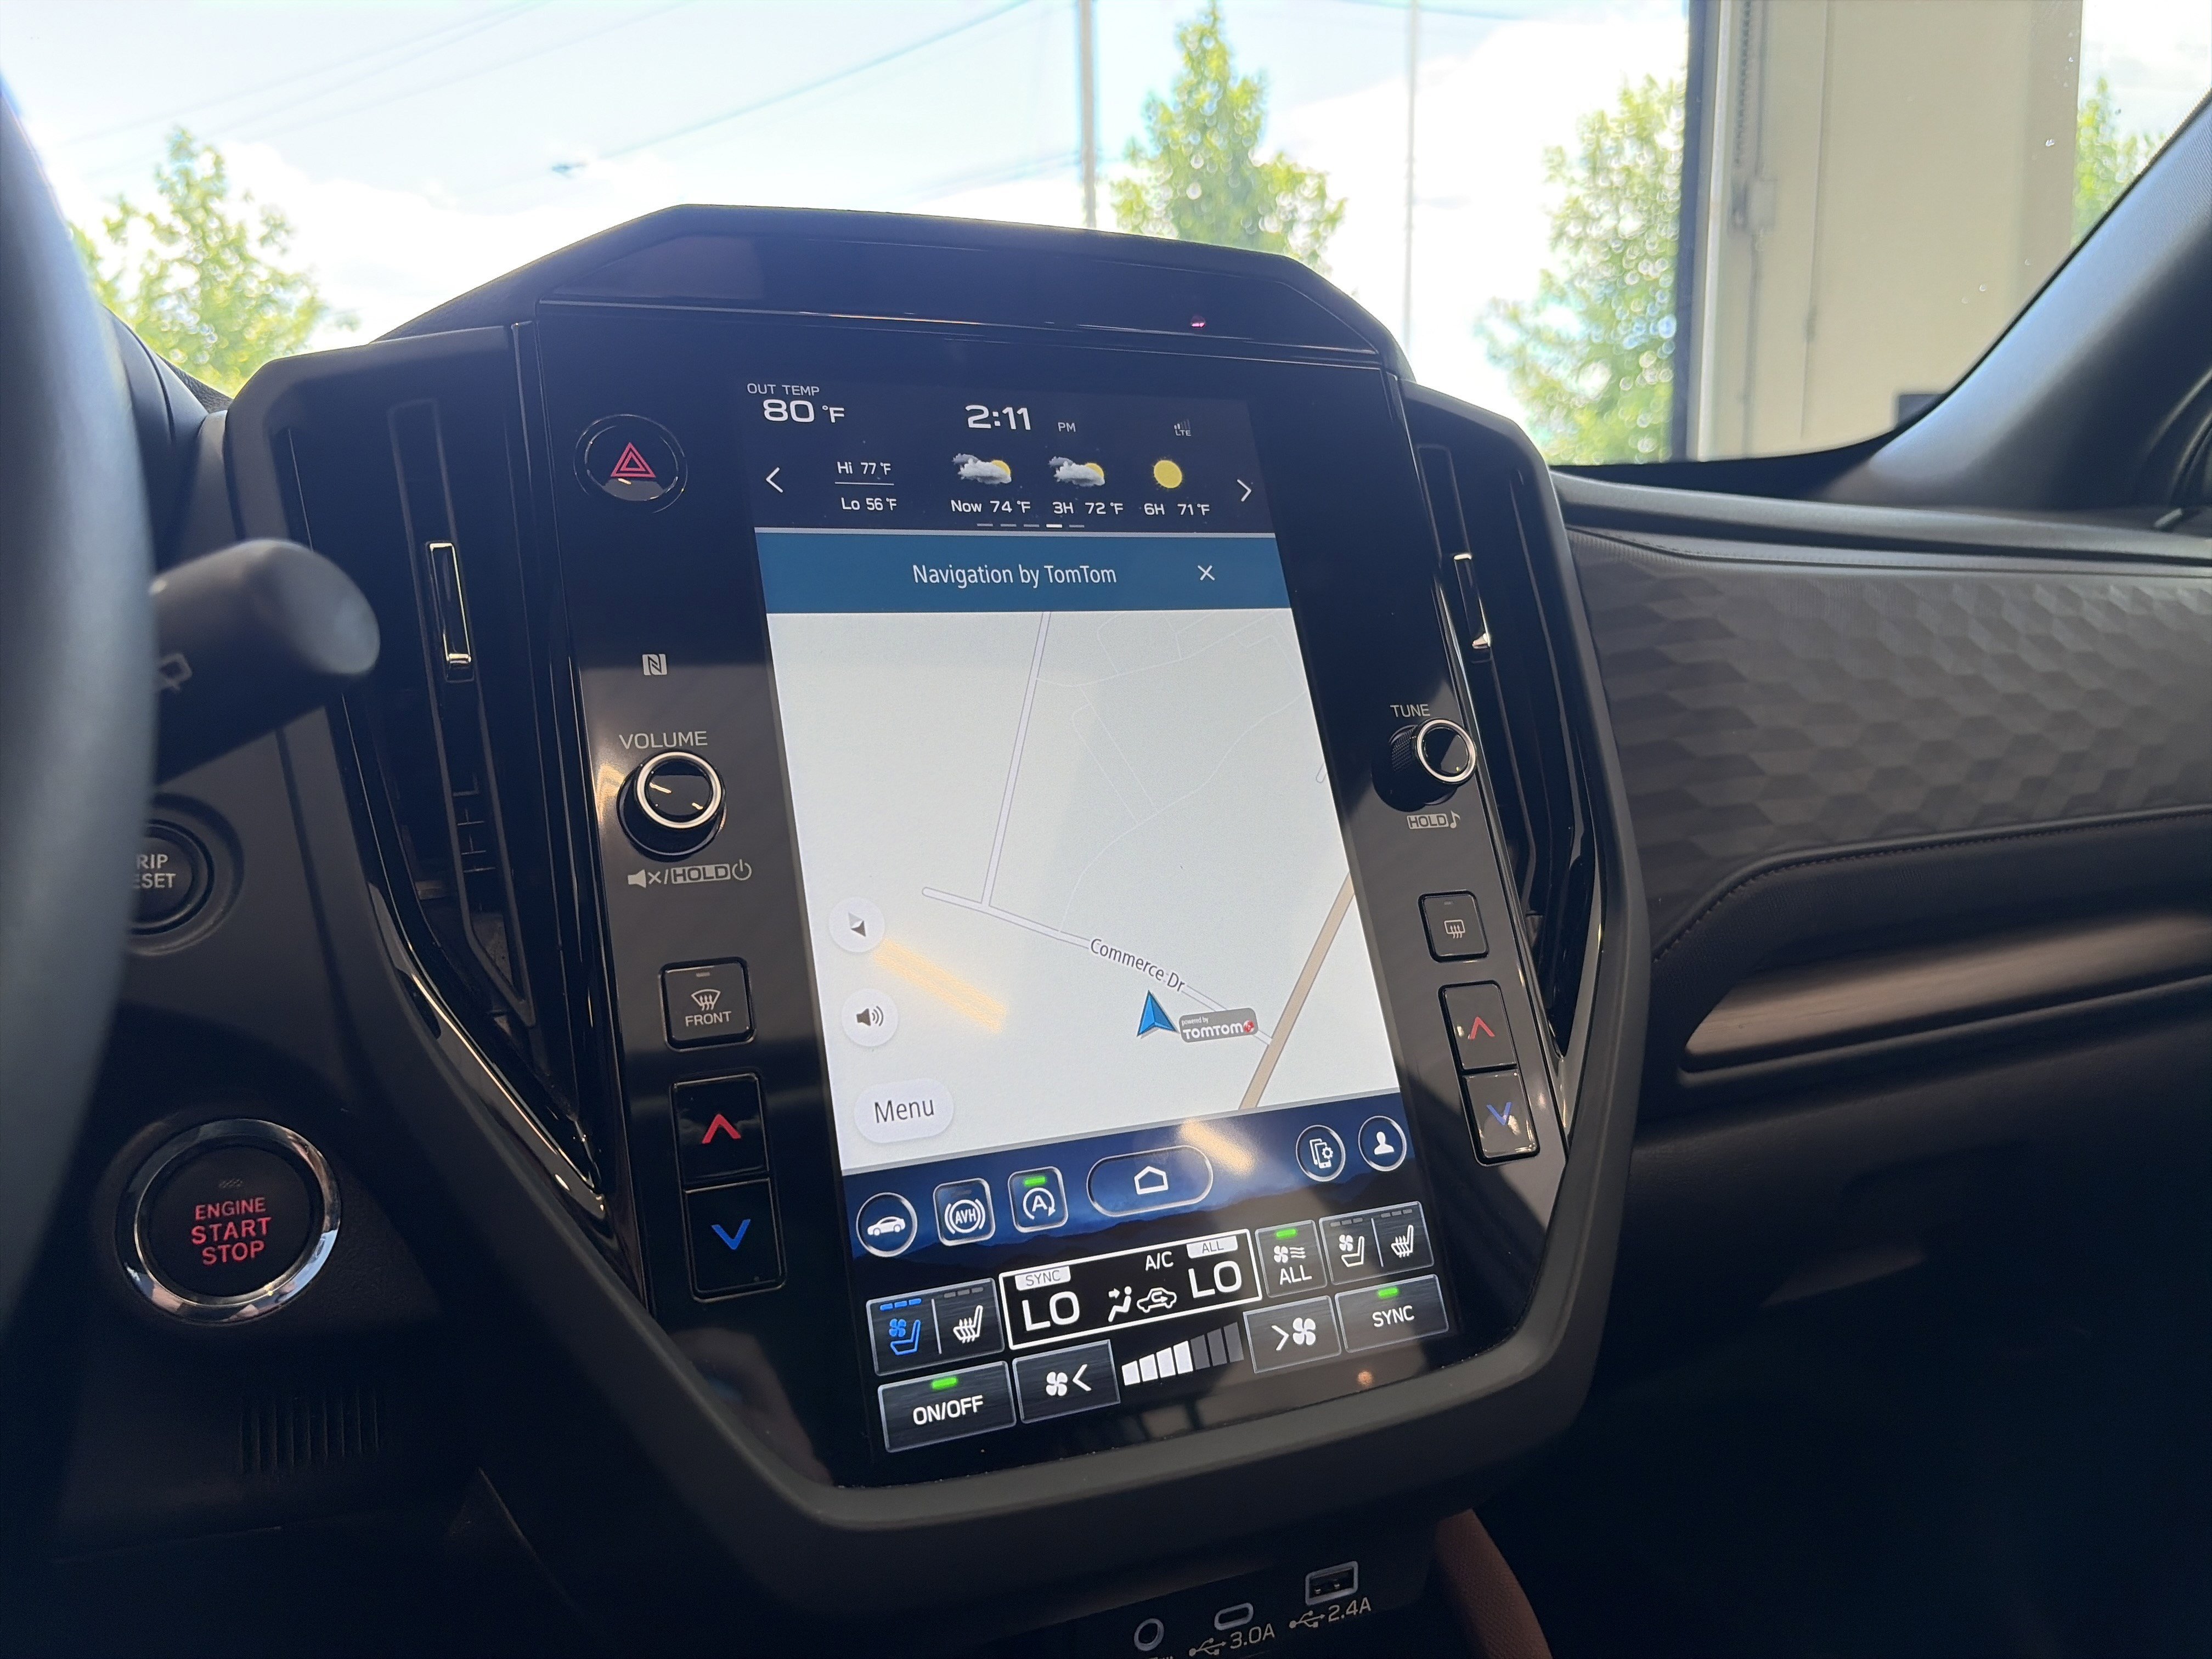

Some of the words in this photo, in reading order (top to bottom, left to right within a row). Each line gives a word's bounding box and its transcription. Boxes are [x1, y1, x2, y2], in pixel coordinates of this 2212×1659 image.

[747, 383, 776, 395] OUT
[782, 385, 820, 397] TEMP
[763, 399, 815, 423] 80
[965, 405, 1031, 430] 2:11
[1058, 422, 1076, 432] PM
[837, 462, 853, 475] Hi
[841, 497, 860, 510] Lo
[951, 500, 982, 513] Now
[1053, 501, 1074, 515] 3H
[1144, 503, 1165, 516] 6H
[912, 564, 1014, 589] Navigation
[1019, 564, 1040, 589] by
[1043, 565, 1117, 584] TomTom
[1390, 704, 1431, 718] TUNE
[619, 731, 708, 749] VOLUME
[1407, 814, 1448, 829] HOLD
[1090, 938, 1164, 982] Commerce
[1166, 972, 1185, 992] Dr
[685, 1011, 731, 1026] FRONT
[874, 1099, 934, 1123] Menu
[195, 1197, 267, 1221] ENGINE
[955, 1207, 977, 1224] AVH
[191, 1217, 272, 1244] START
[202, 1240, 265, 1266] STOP
[1201, 1242, 1225, 1254] ALL
[1145, 1251, 1174, 1271] A/C
[1024, 1270, 1062, 1286] SYNC
[1188, 1261, 1243, 1299] LO
[1279, 1265, 1312, 1285] ALL
[1022, 1291, 1080, 1331] LO
[1372, 1305, 1415, 1328] SYNC
[913, 1395, 984, 1426] ON/OFF
[1328, 1596, 1372, 1622] 2.4A
[1230, 1623, 1276, 1650] 3.0A
